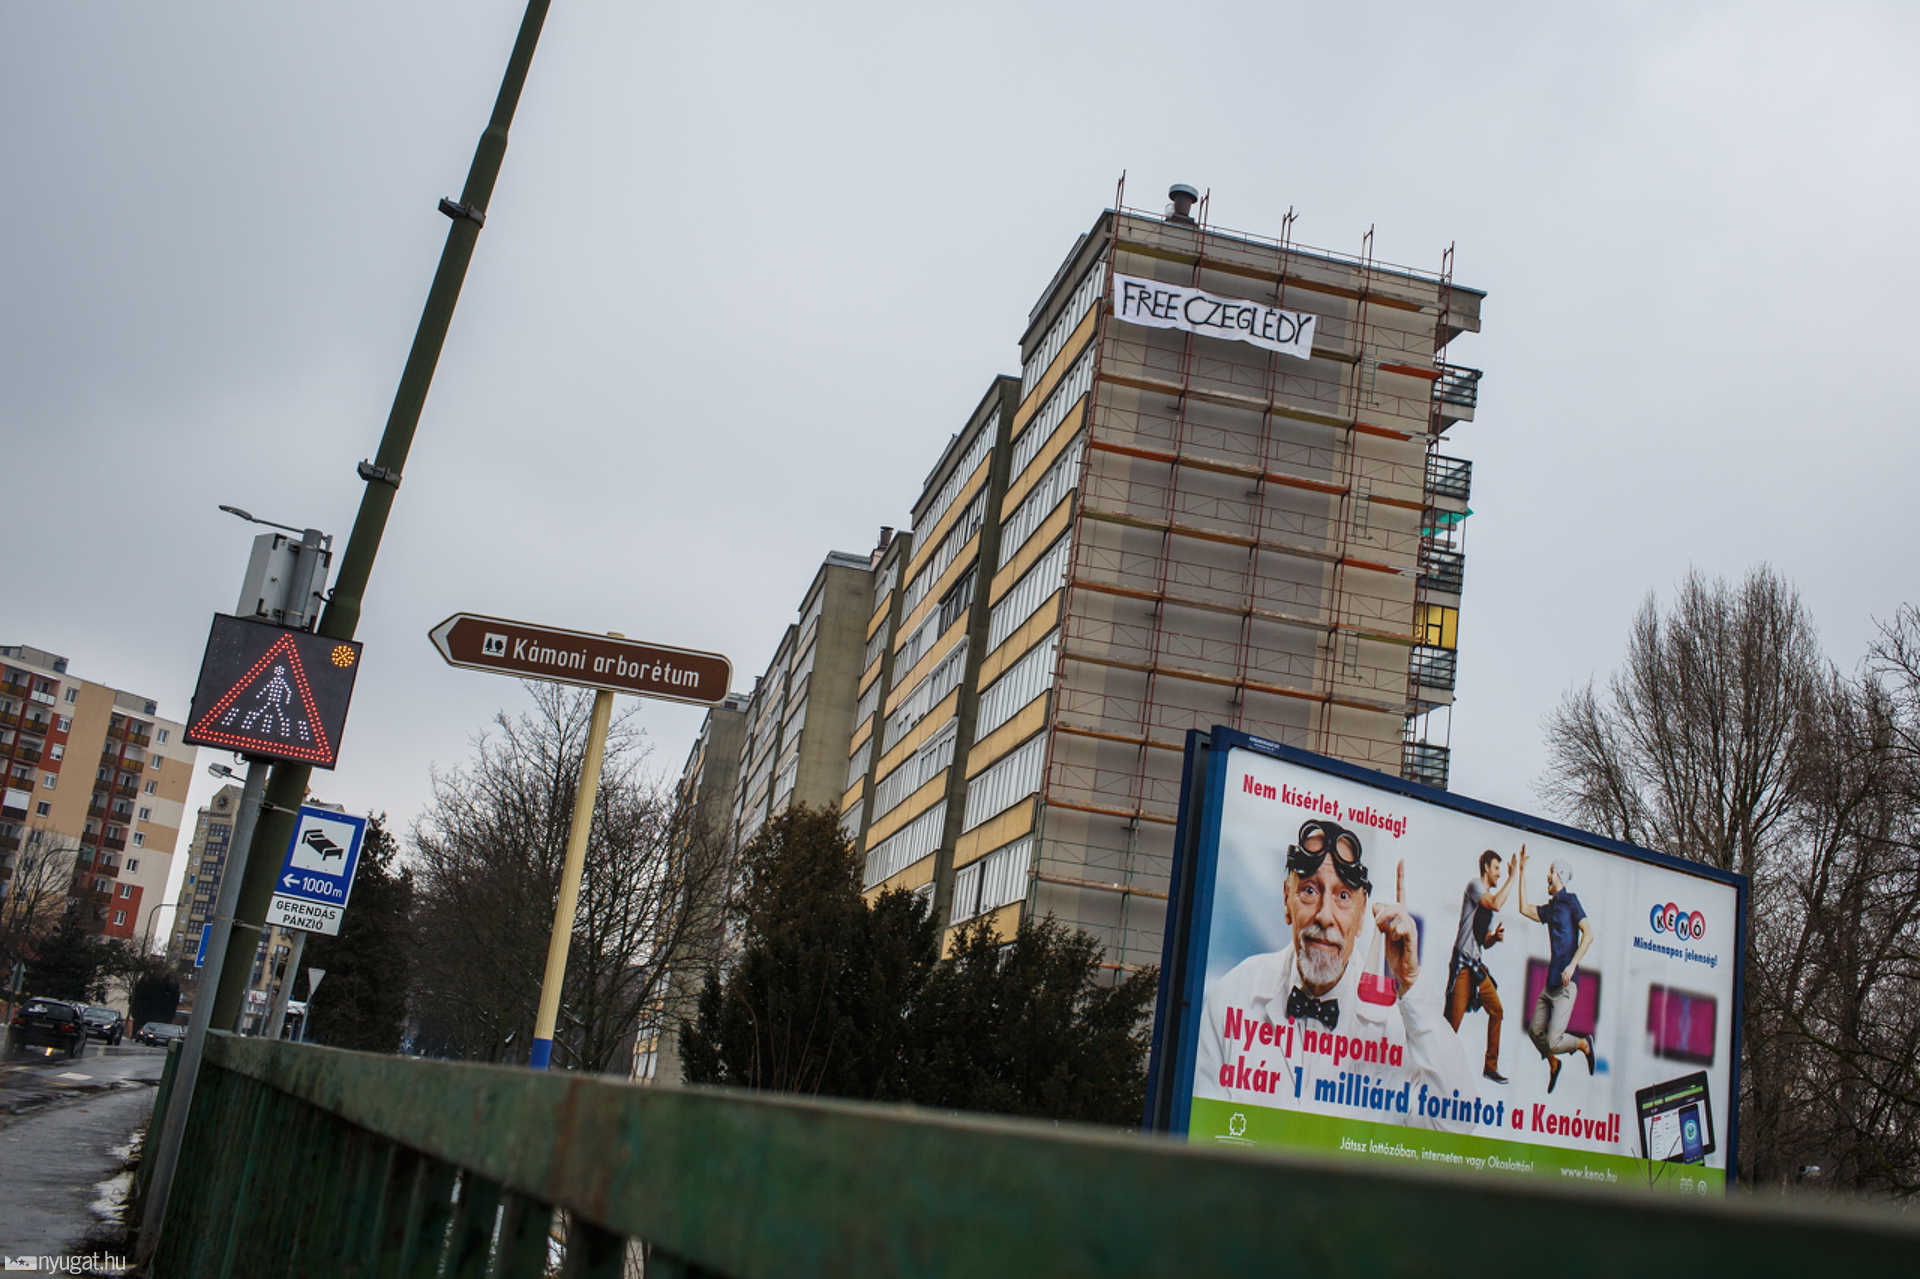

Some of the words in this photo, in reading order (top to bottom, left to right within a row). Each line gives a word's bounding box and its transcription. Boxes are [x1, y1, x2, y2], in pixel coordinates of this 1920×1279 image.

[1121, 280, 1181, 320] FREE
[1184, 296, 1312, 345] CZEGLÉDY
[513, 637, 587, 670] Kámoni
[593, 654, 700, 687] arborétum
[1243, 774, 1276, 801] Nem
[1348, 805, 1407, 839] valóság!
[276, 899, 336, 921] GERENDÁS
[282, 913, 324, 931] PÁNZIÓ
[1633, 936, 1683, 959] Mindennapos
[1223, 1006, 1295, 1058] Nyerj
[1302, 1028, 1403, 1067] naponta
[1218, 1055, 1281, 1094] akár
[1294, 1066, 1303, 1098] 1
[1314, 1071, 1410, 1114] milliárd
[1418, 1084, 1505, 1127] forintot
[1511, 1107, 1524, 1131] a
[1531, 1103, 1621, 1144] Kenóval!
